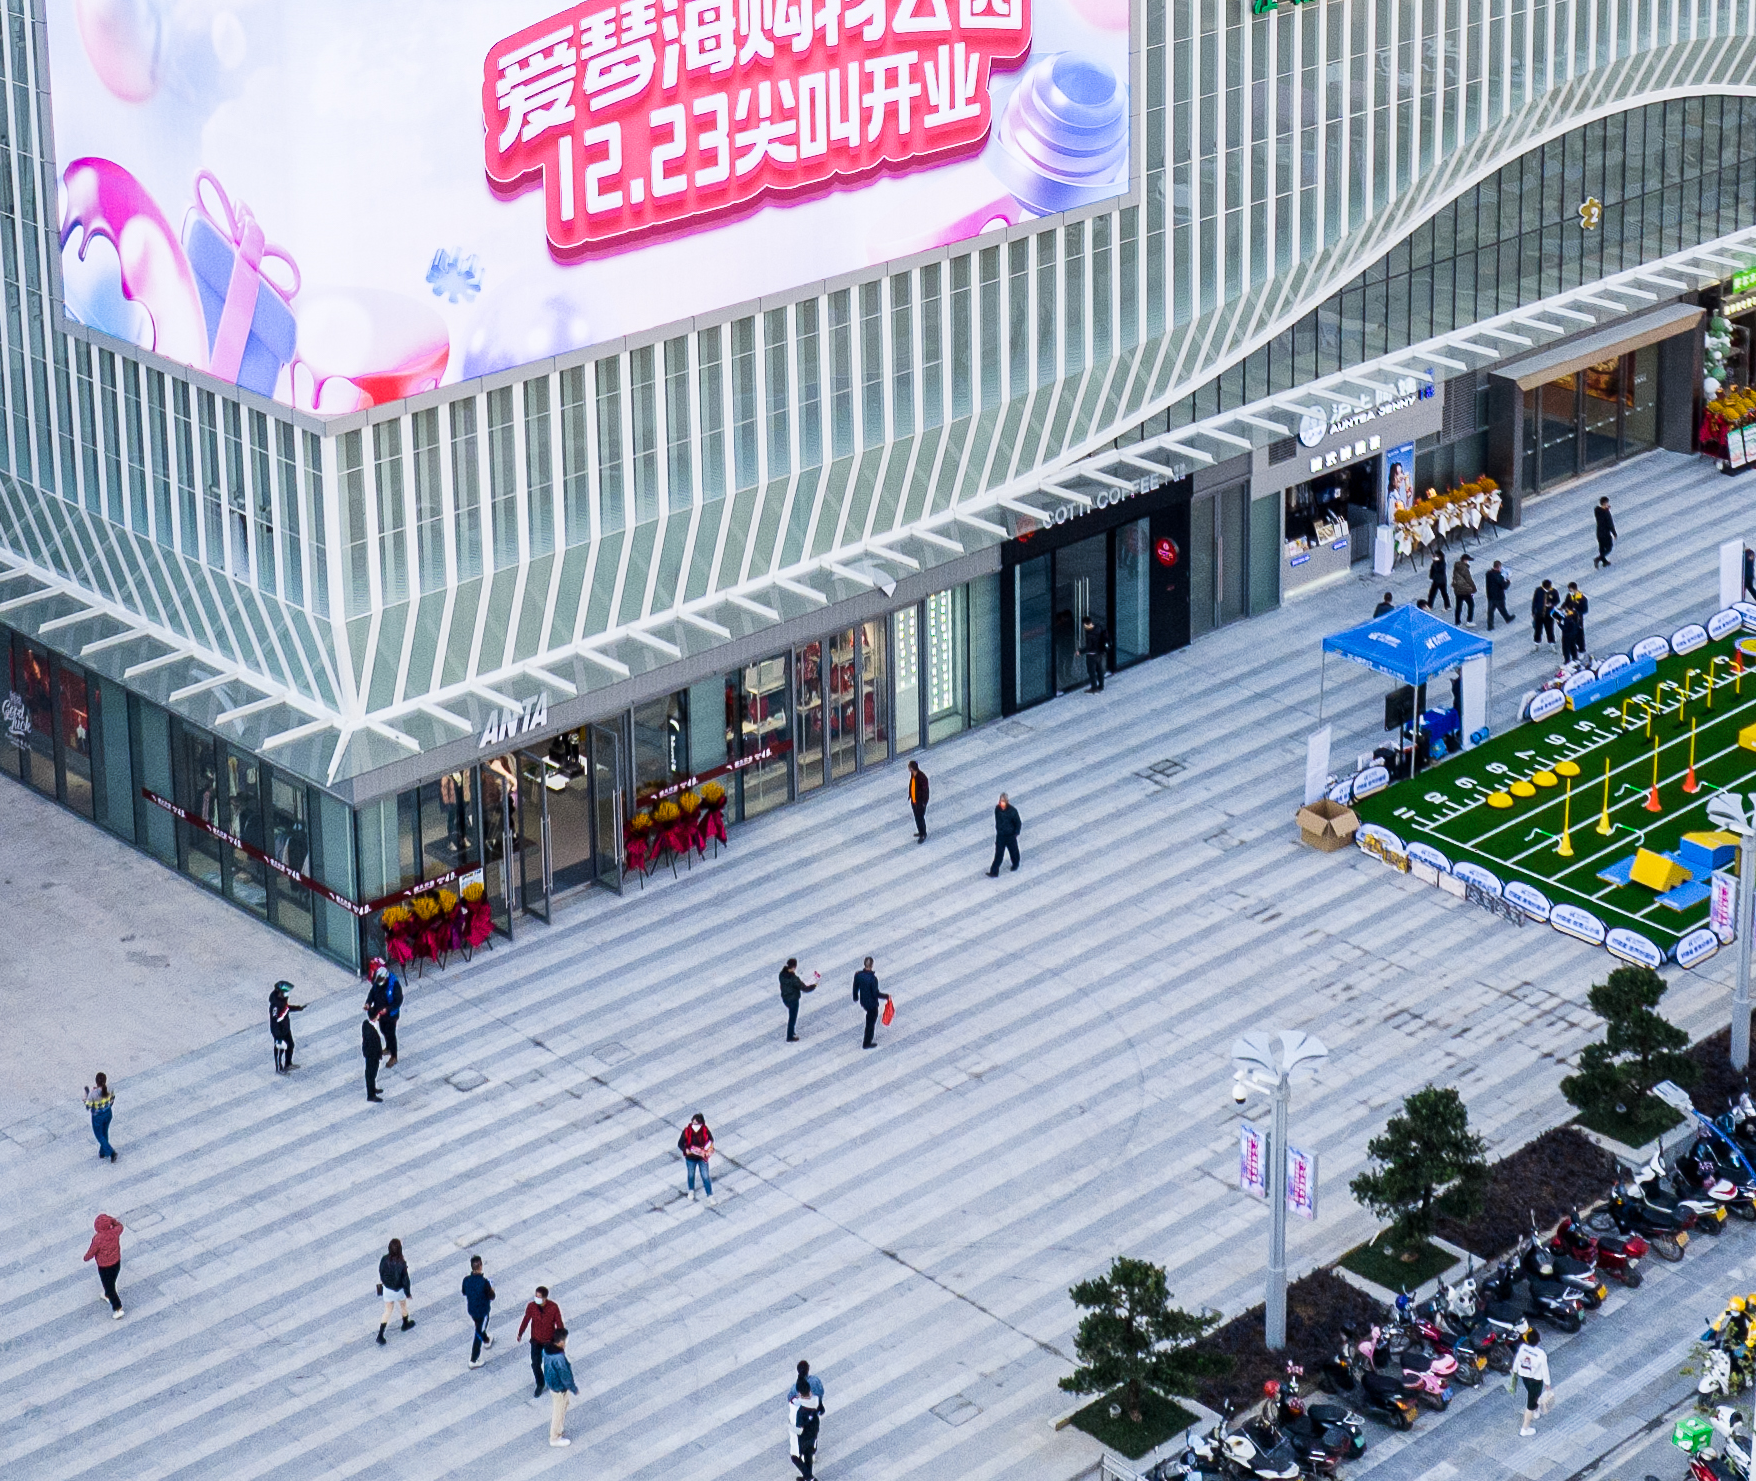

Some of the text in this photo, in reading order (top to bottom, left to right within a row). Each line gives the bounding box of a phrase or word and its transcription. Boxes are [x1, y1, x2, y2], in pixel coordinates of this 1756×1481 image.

[555, 42, 982, 222] 12.23尖叫开业
[1330, 396, 1417, 435] AUNTEA JENNY
[479, 692, 548, 749] ANTA
